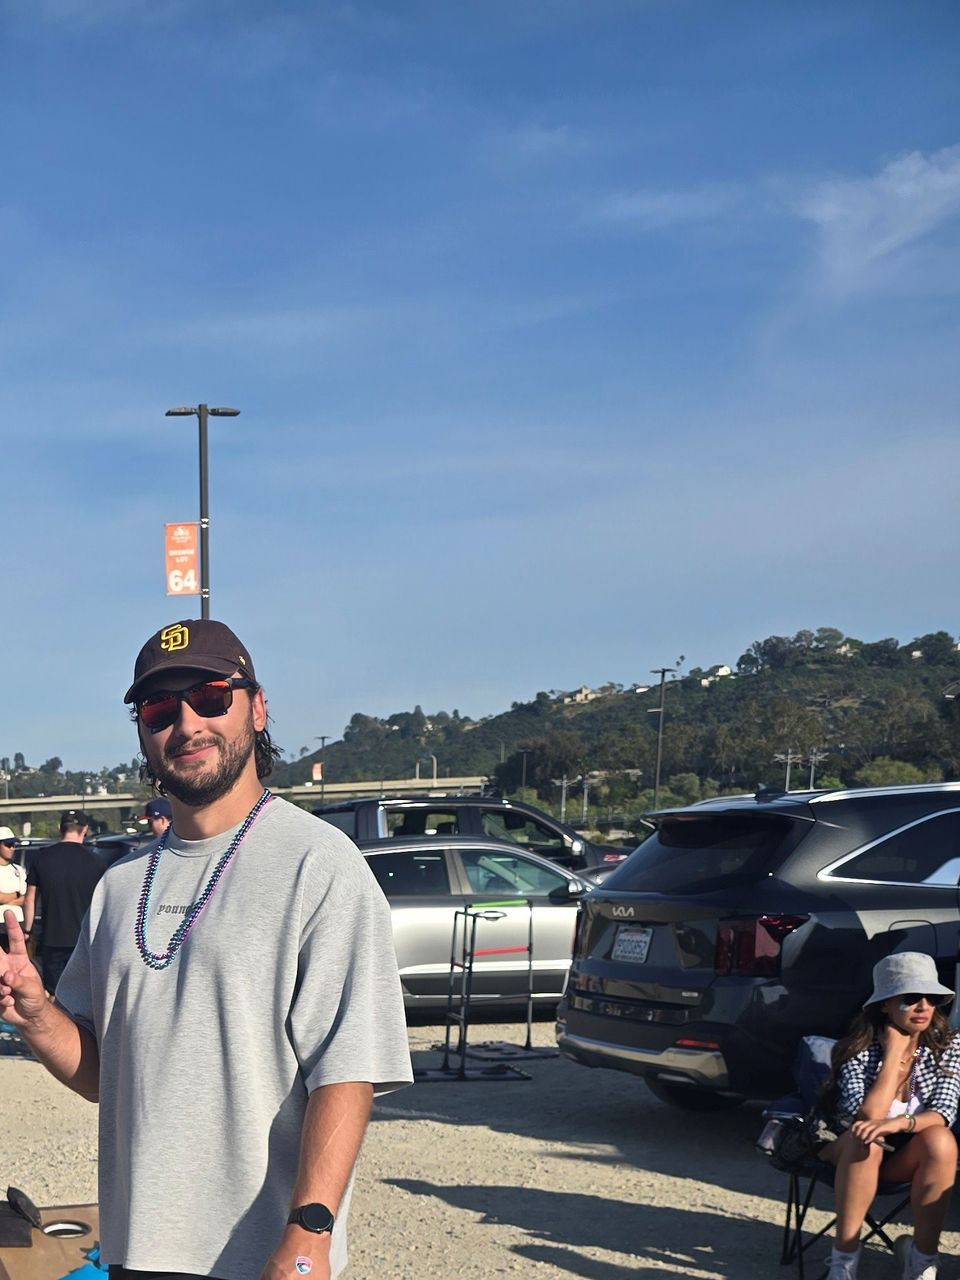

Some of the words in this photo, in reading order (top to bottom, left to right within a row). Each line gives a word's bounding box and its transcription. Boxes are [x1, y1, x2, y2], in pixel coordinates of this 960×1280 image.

[169, 569, 196, 592] 64
[161, 624, 189, 652] SD
[612, 906, 635, 917] KIA
